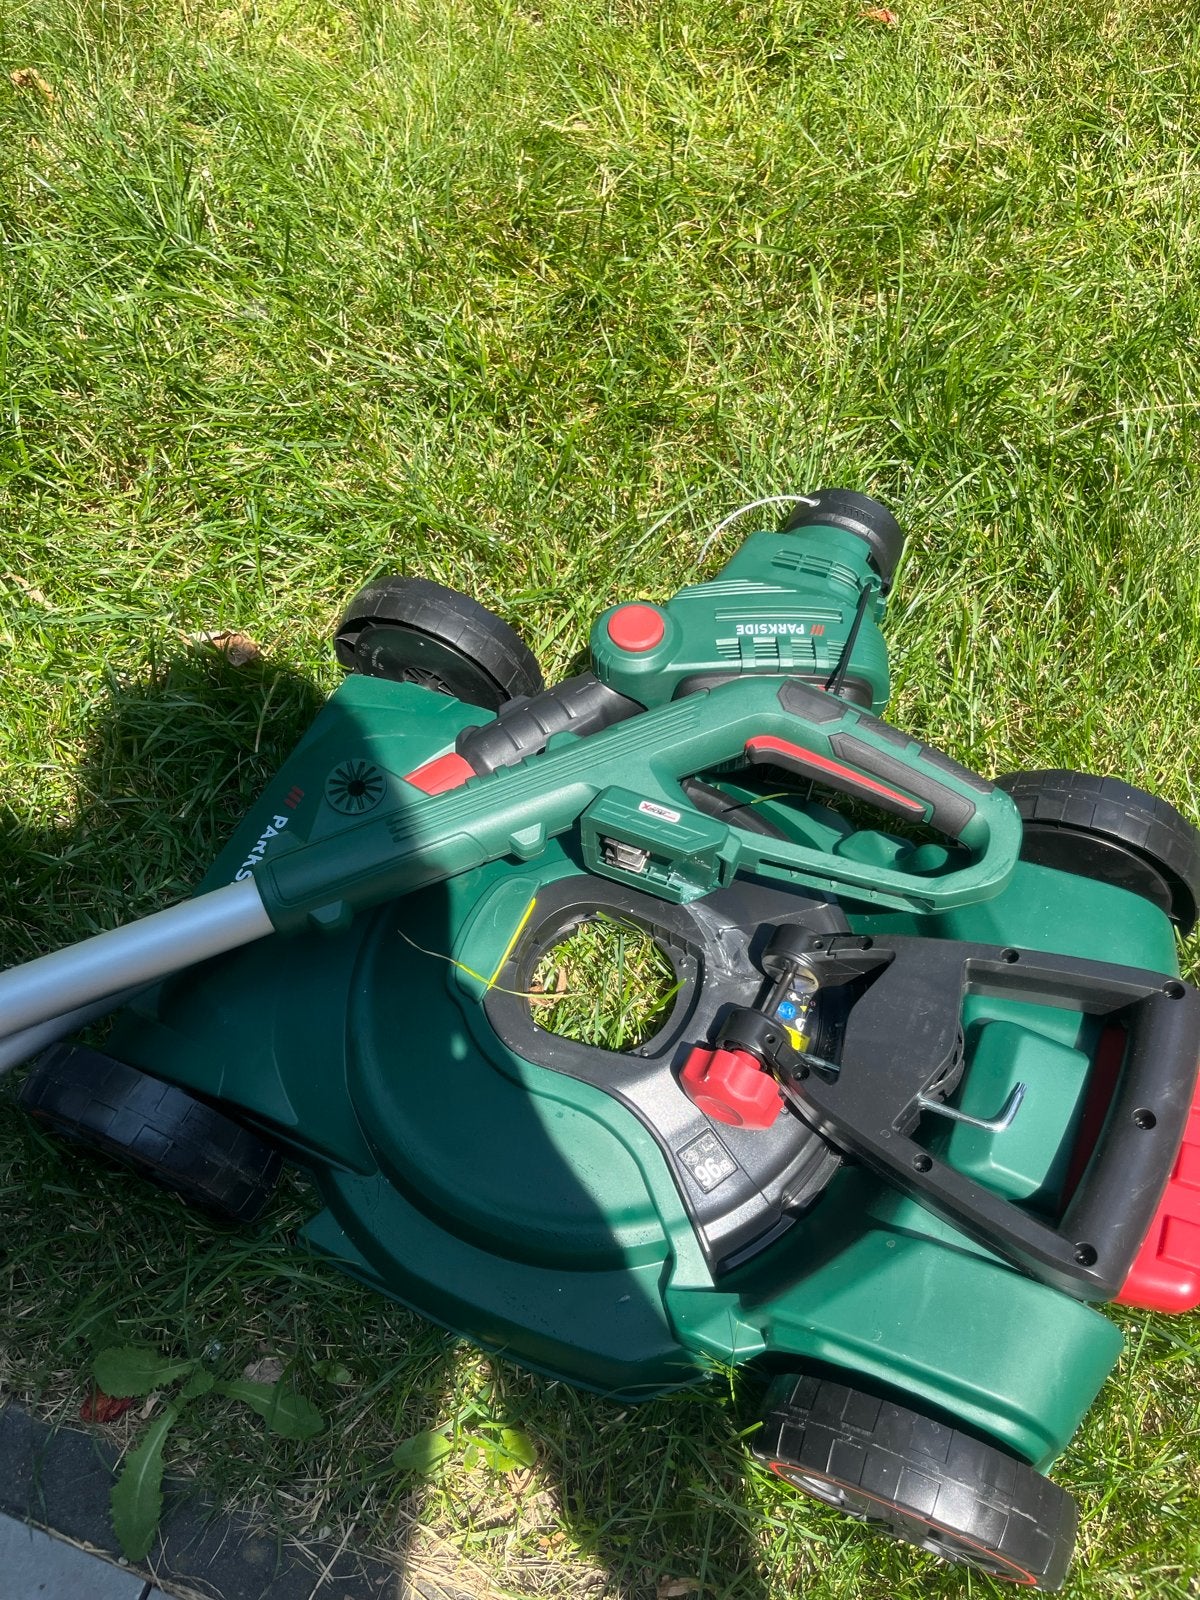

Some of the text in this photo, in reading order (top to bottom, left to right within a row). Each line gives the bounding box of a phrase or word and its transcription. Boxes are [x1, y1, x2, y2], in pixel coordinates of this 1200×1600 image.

[736, 623, 805, 635] PARKSIDE
[235, 815, 289, 881] PARKS
[695, 1158, 722, 1186] 96
